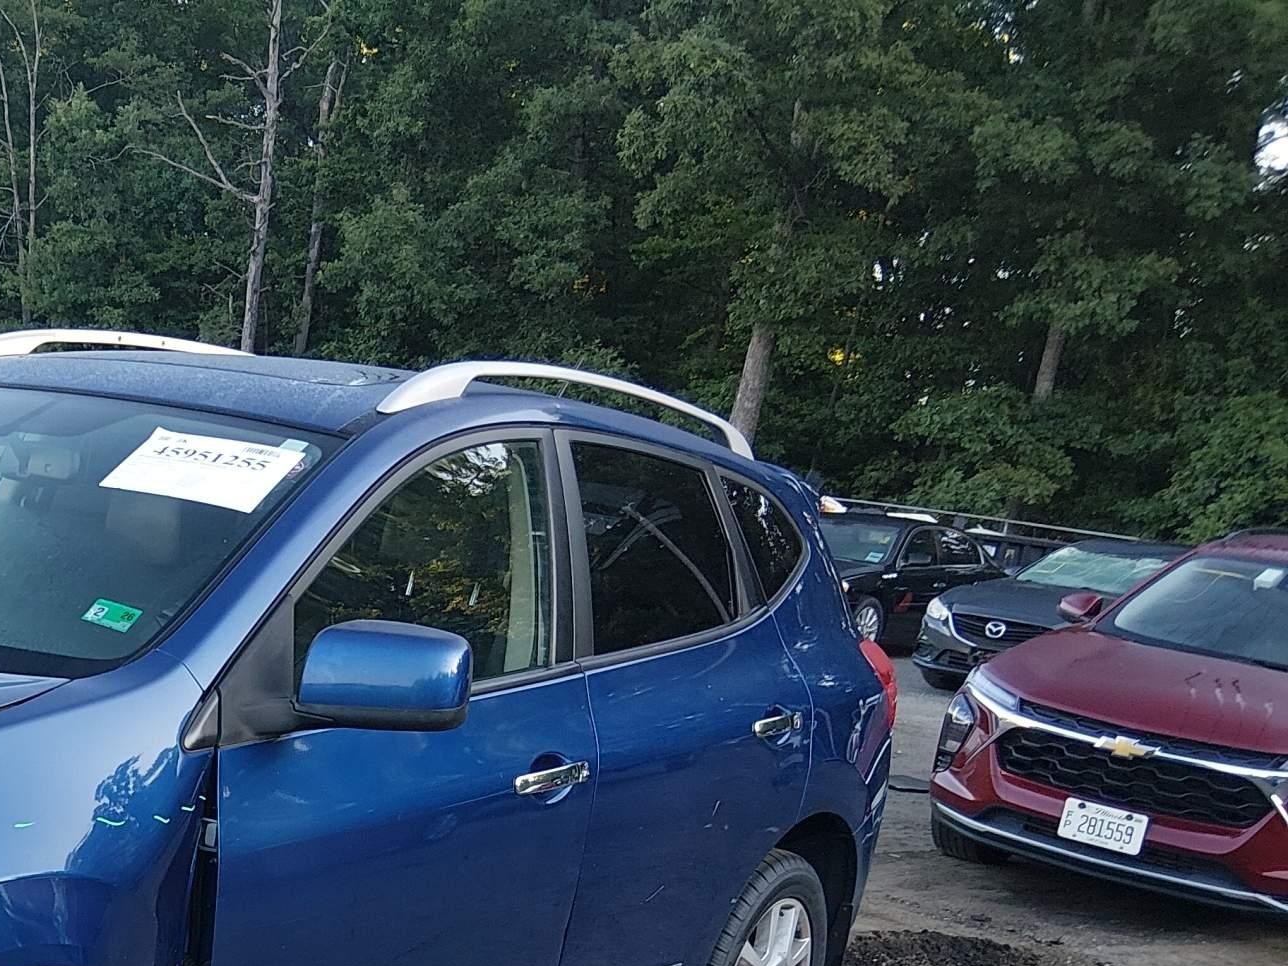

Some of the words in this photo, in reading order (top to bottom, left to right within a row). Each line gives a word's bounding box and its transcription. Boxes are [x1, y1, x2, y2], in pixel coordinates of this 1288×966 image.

[153, 446, 271, 471] 45951255
[93, 608, 104, 617] 2
[1077, 814, 1135, 845] 281559
